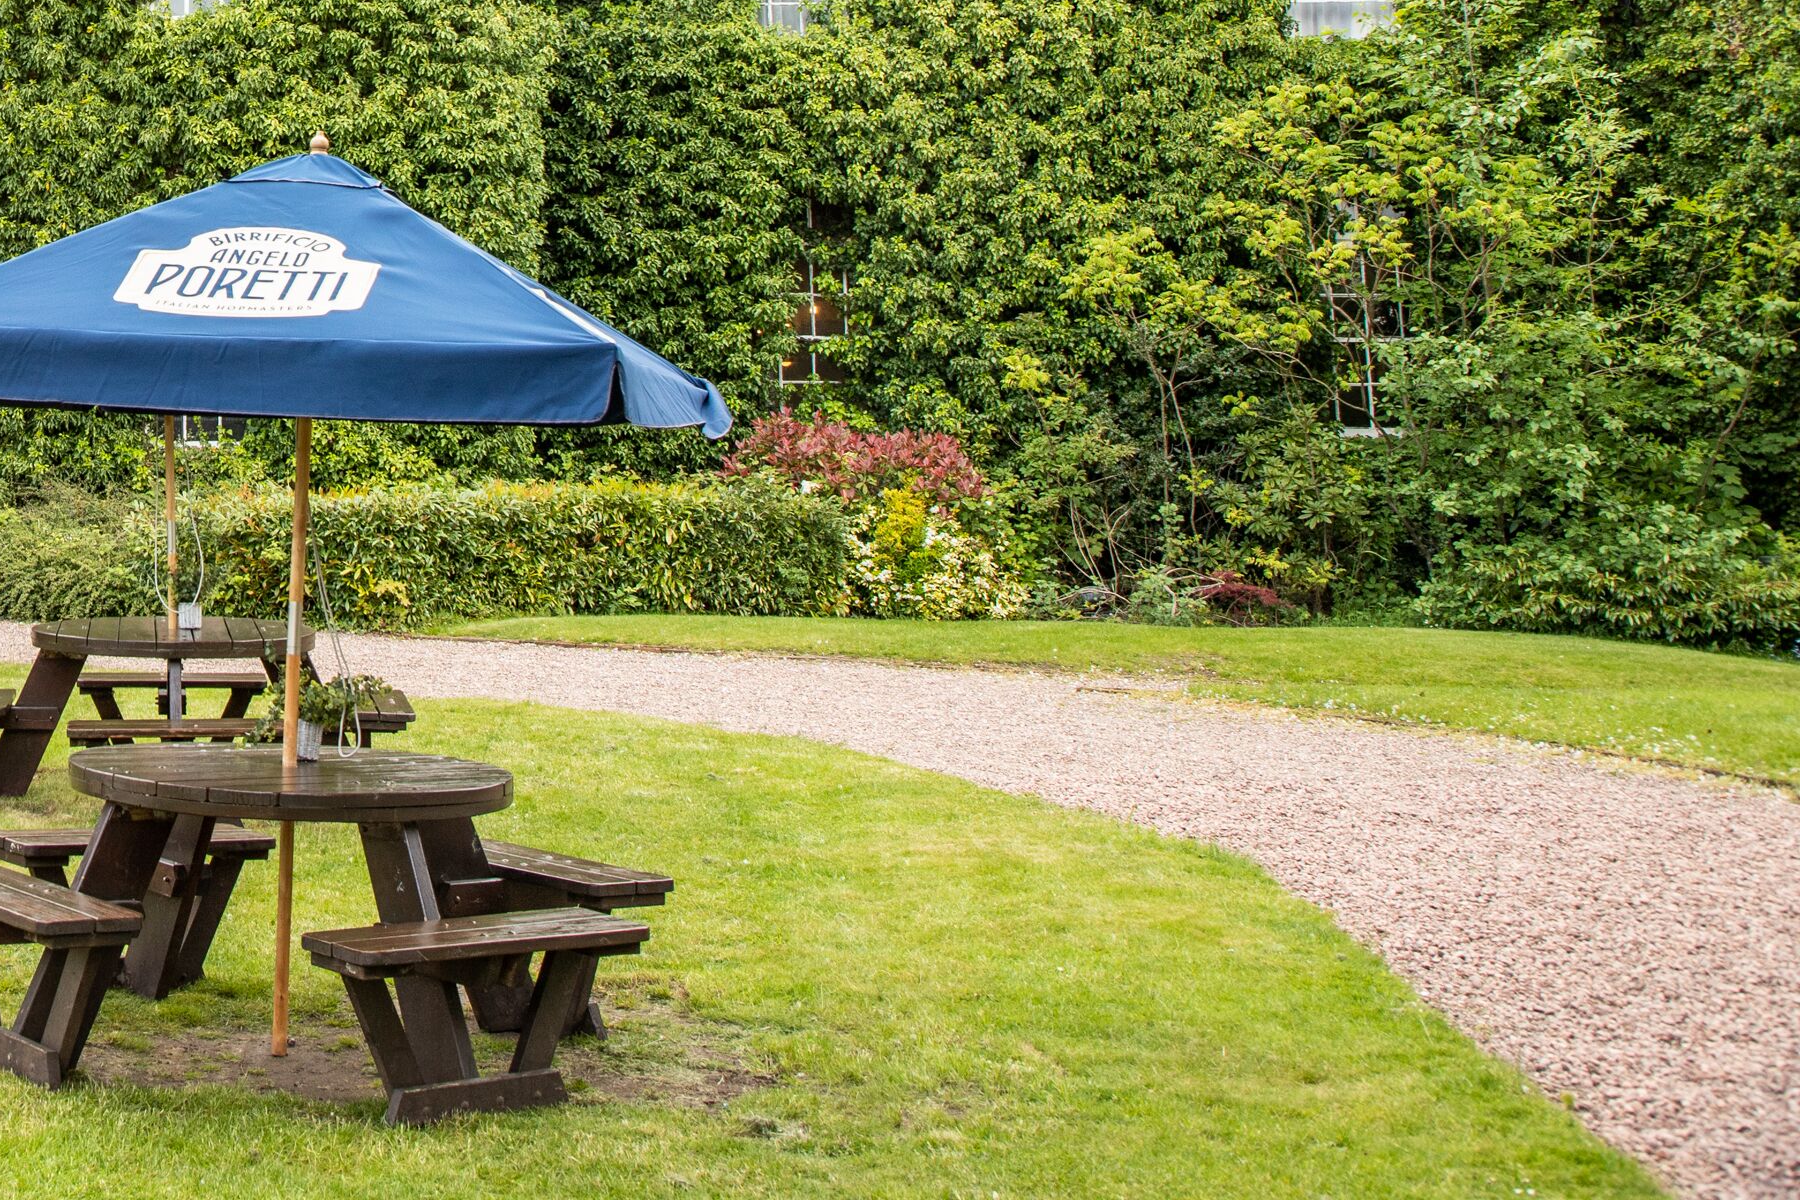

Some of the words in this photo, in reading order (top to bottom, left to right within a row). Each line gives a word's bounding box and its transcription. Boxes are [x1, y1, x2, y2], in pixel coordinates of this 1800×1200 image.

[208, 231, 331, 253] BIRRIFICIO
[209, 248, 311, 268] ANGELO
[144, 263, 349, 302] PORETTI
